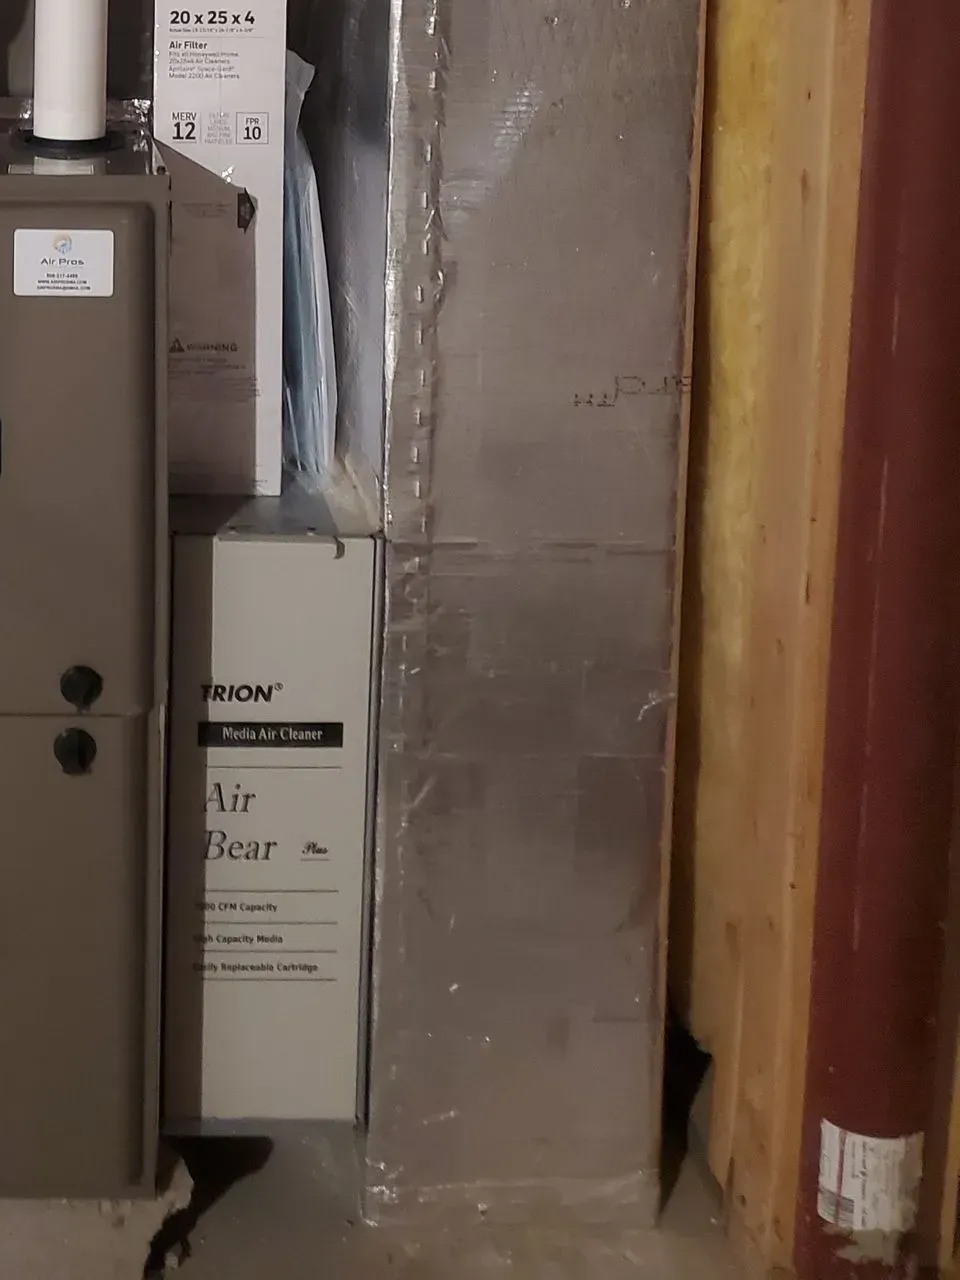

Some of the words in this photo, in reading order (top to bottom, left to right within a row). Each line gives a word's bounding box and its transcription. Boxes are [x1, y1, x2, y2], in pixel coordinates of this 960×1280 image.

[169, 10, 191, 25] 20
[193, 13, 204, 25] x
[207, 10, 228, 25] 25
[231, 13, 242, 25] x
[243, 10, 256, 25] 4
[169, 40, 182, 49] Air
[184, 40, 208, 49] Filter
[172, 111, 197, 121] MERV
[245, 117, 260, 126] FPR
[172, 121, 197, 141] 12
[243, 126, 262, 140] 10
[40, 258, 54, 266] Air
[59, 258, 85, 266] Pros
[222, 727, 257, 741] Media
[258, 727, 277, 741] Air
[280, 727, 324, 741] Cleaner
[204, 782, 257, 813] Air
[204, 830, 278, 861] Bear
[218, 903, 237, 912] CFM
[239, 903, 278, 913] Capacity
[215, 934, 255, 945] Capacity
[256, 934, 284, 944] Media
[221, 962, 274, 972] Replaceable
[276, 963, 319, 974] Cartridge
